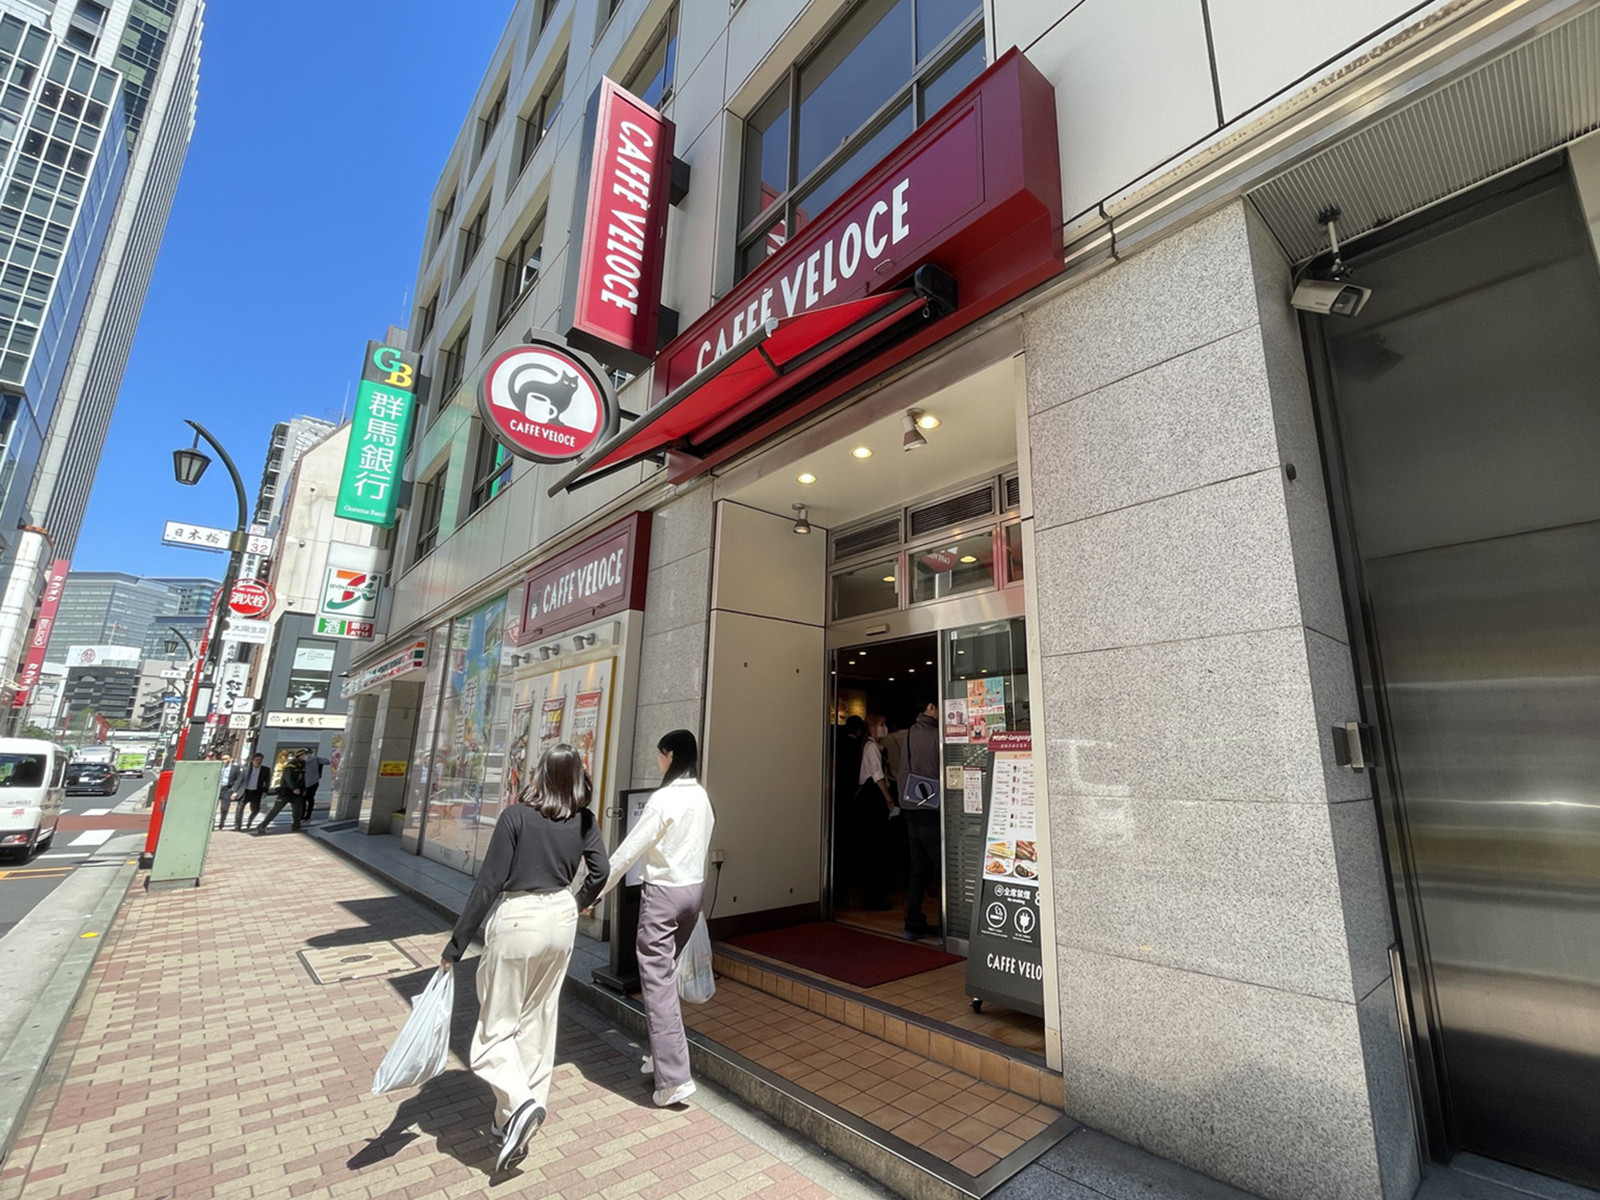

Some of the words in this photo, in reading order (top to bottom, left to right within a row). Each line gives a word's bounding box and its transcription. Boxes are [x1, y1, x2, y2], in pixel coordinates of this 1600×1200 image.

[780, 176, 910, 318] VELOCE
[601, 208, 647, 316] VELOCE
[354, 391, 404, 500] 群馬銀行
[541, 427, 576, 447] VELOCE
[250, 542, 268, 553] 32
[577, 548, 624, 599] VELOCE
[47, 575, 64, 602] カラオケ
[230, 591, 267, 608] 消火栓
[324, 619, 341, 635] 酒
